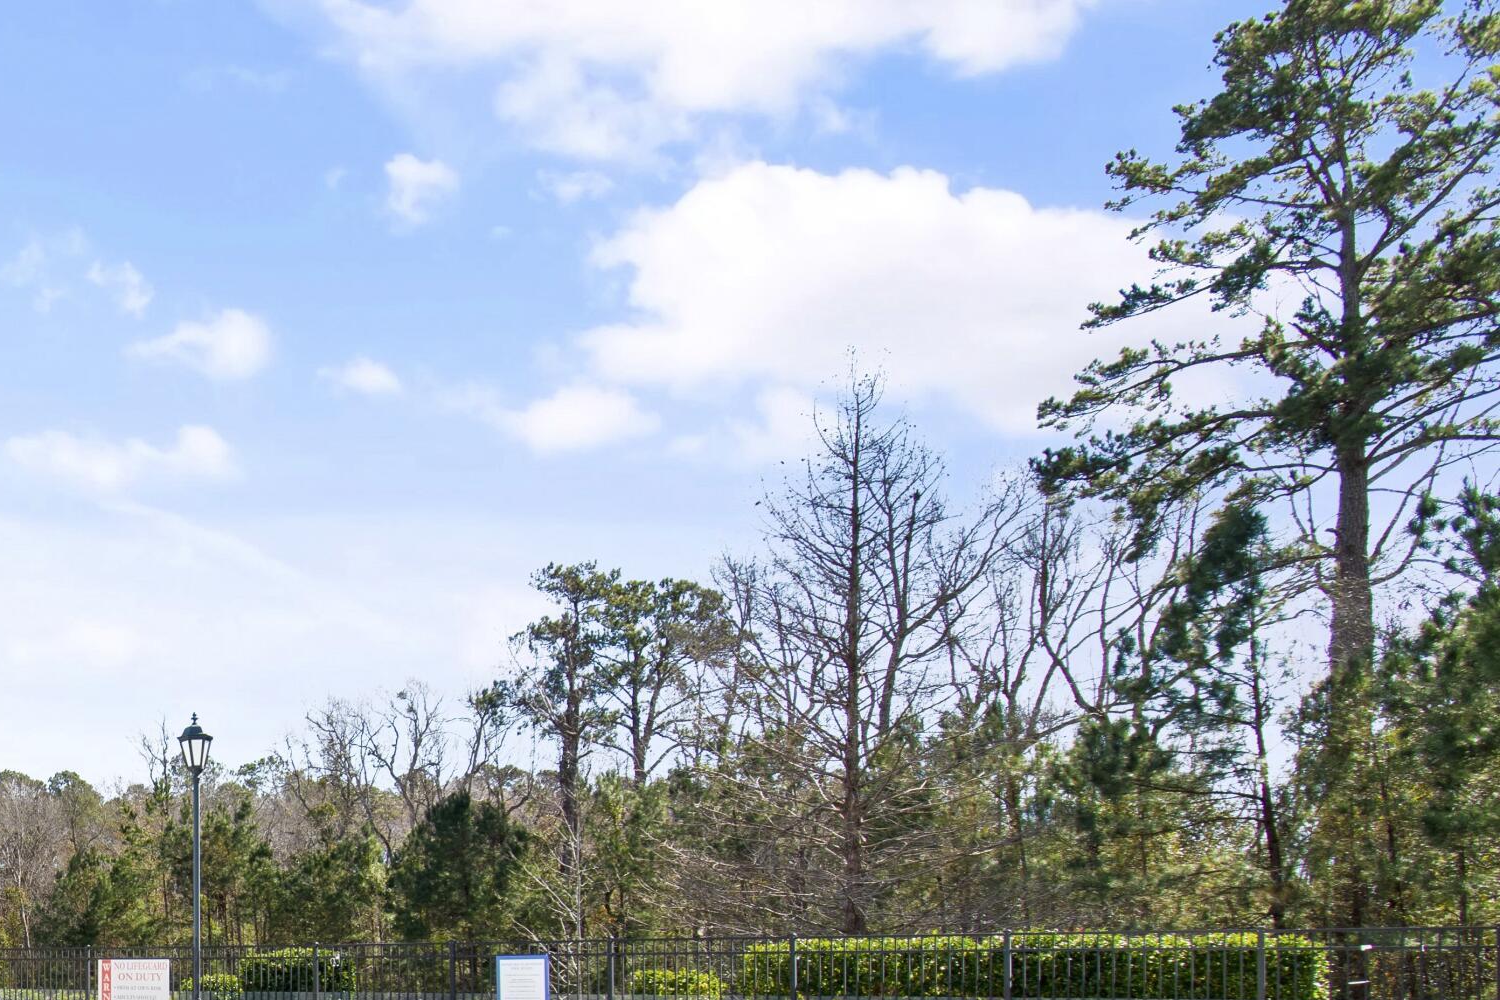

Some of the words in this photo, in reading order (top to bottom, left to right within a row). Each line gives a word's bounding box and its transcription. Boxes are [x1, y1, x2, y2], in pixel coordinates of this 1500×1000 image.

[114, 962, 125, 970] NO
[127, 962, 168, 971] LIFEGUARD
[118, 972, 133, 981] ON
[135, 972, 163, 982] DUTY
